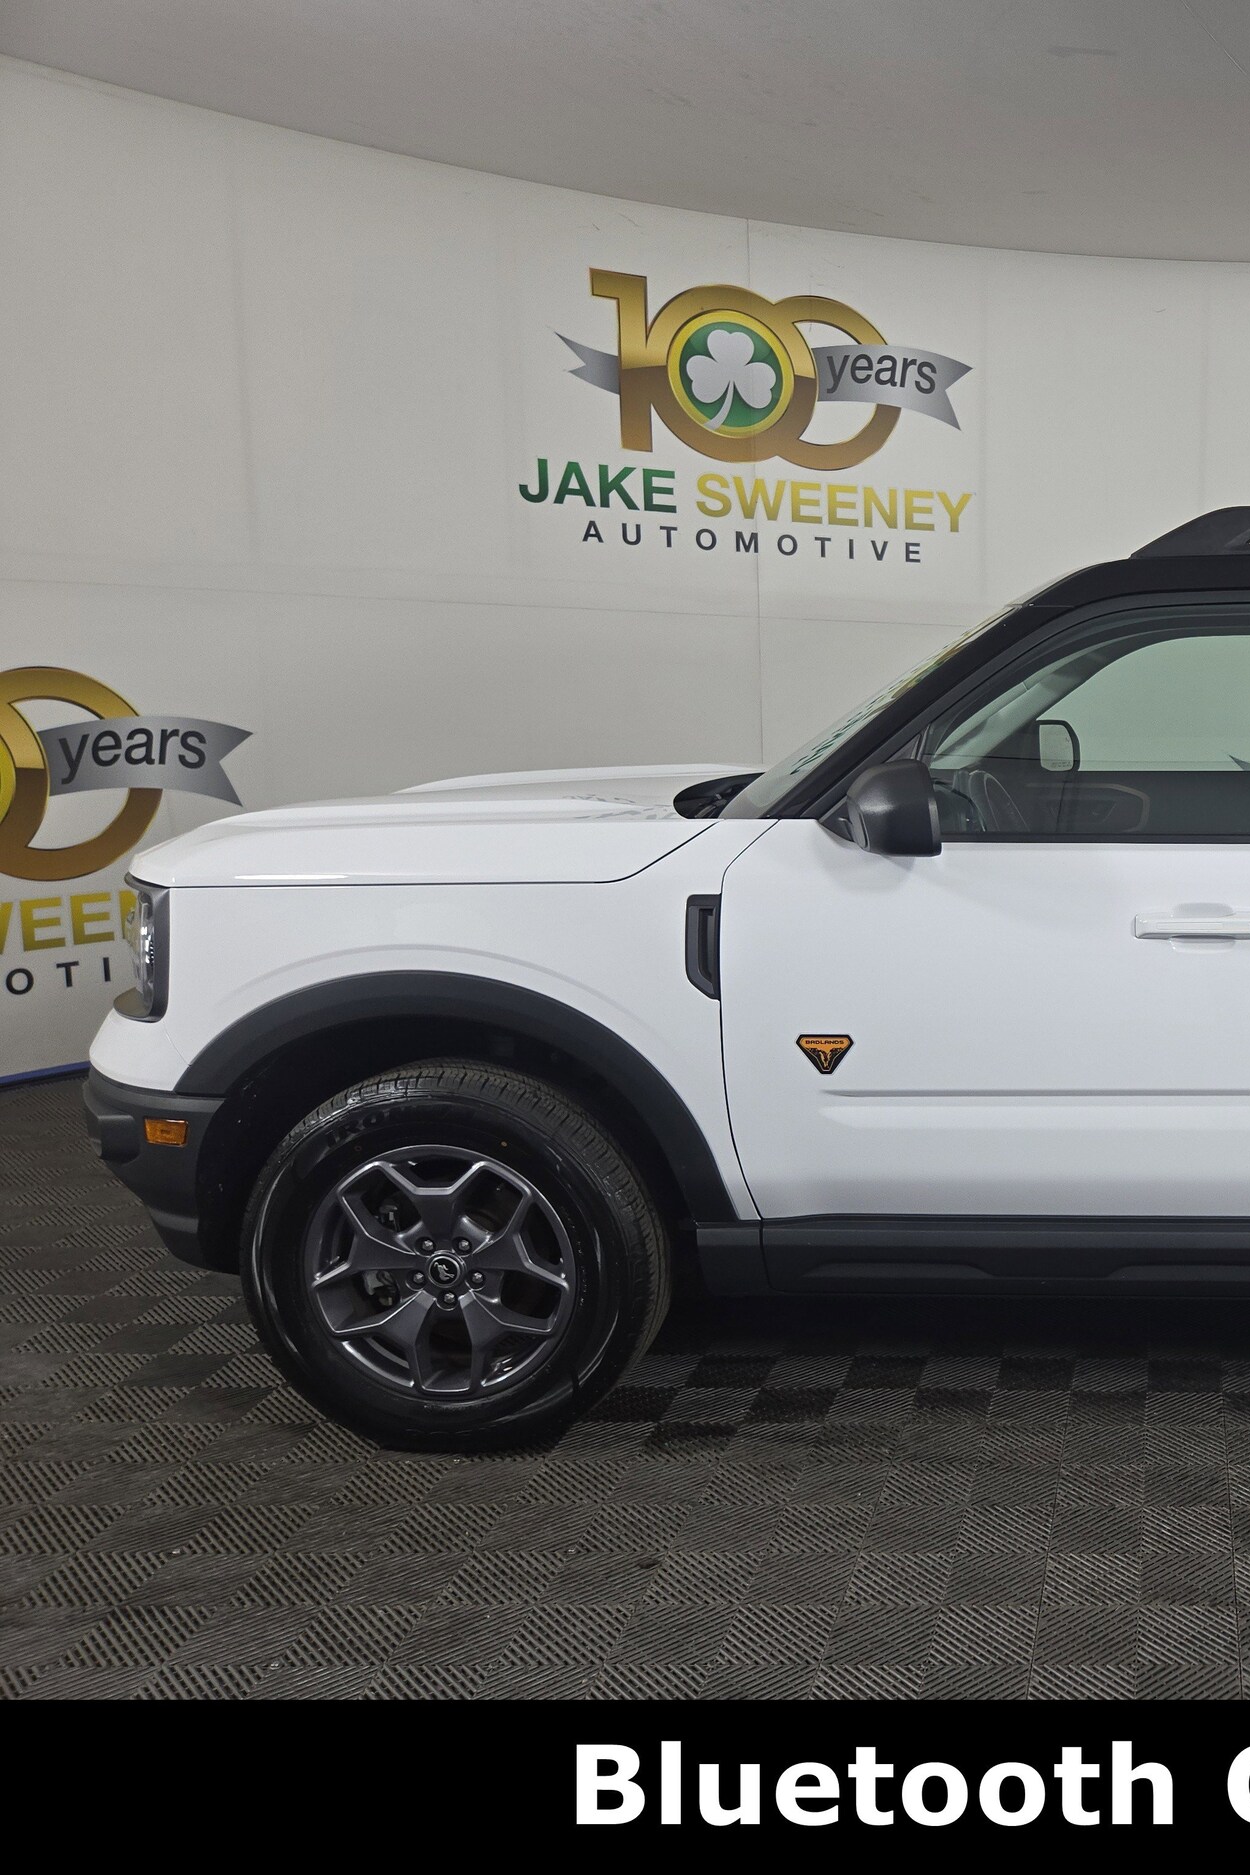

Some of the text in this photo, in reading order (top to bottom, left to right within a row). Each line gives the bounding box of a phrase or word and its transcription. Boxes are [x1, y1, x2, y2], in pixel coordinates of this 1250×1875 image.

[589, 267, 938, 471] 100 years
[519, 457, 973, 533] JAKE SWEENEY
[582, 520, 922, 563] AUTOMOTIVE
[58, 727, 207, 785] years
